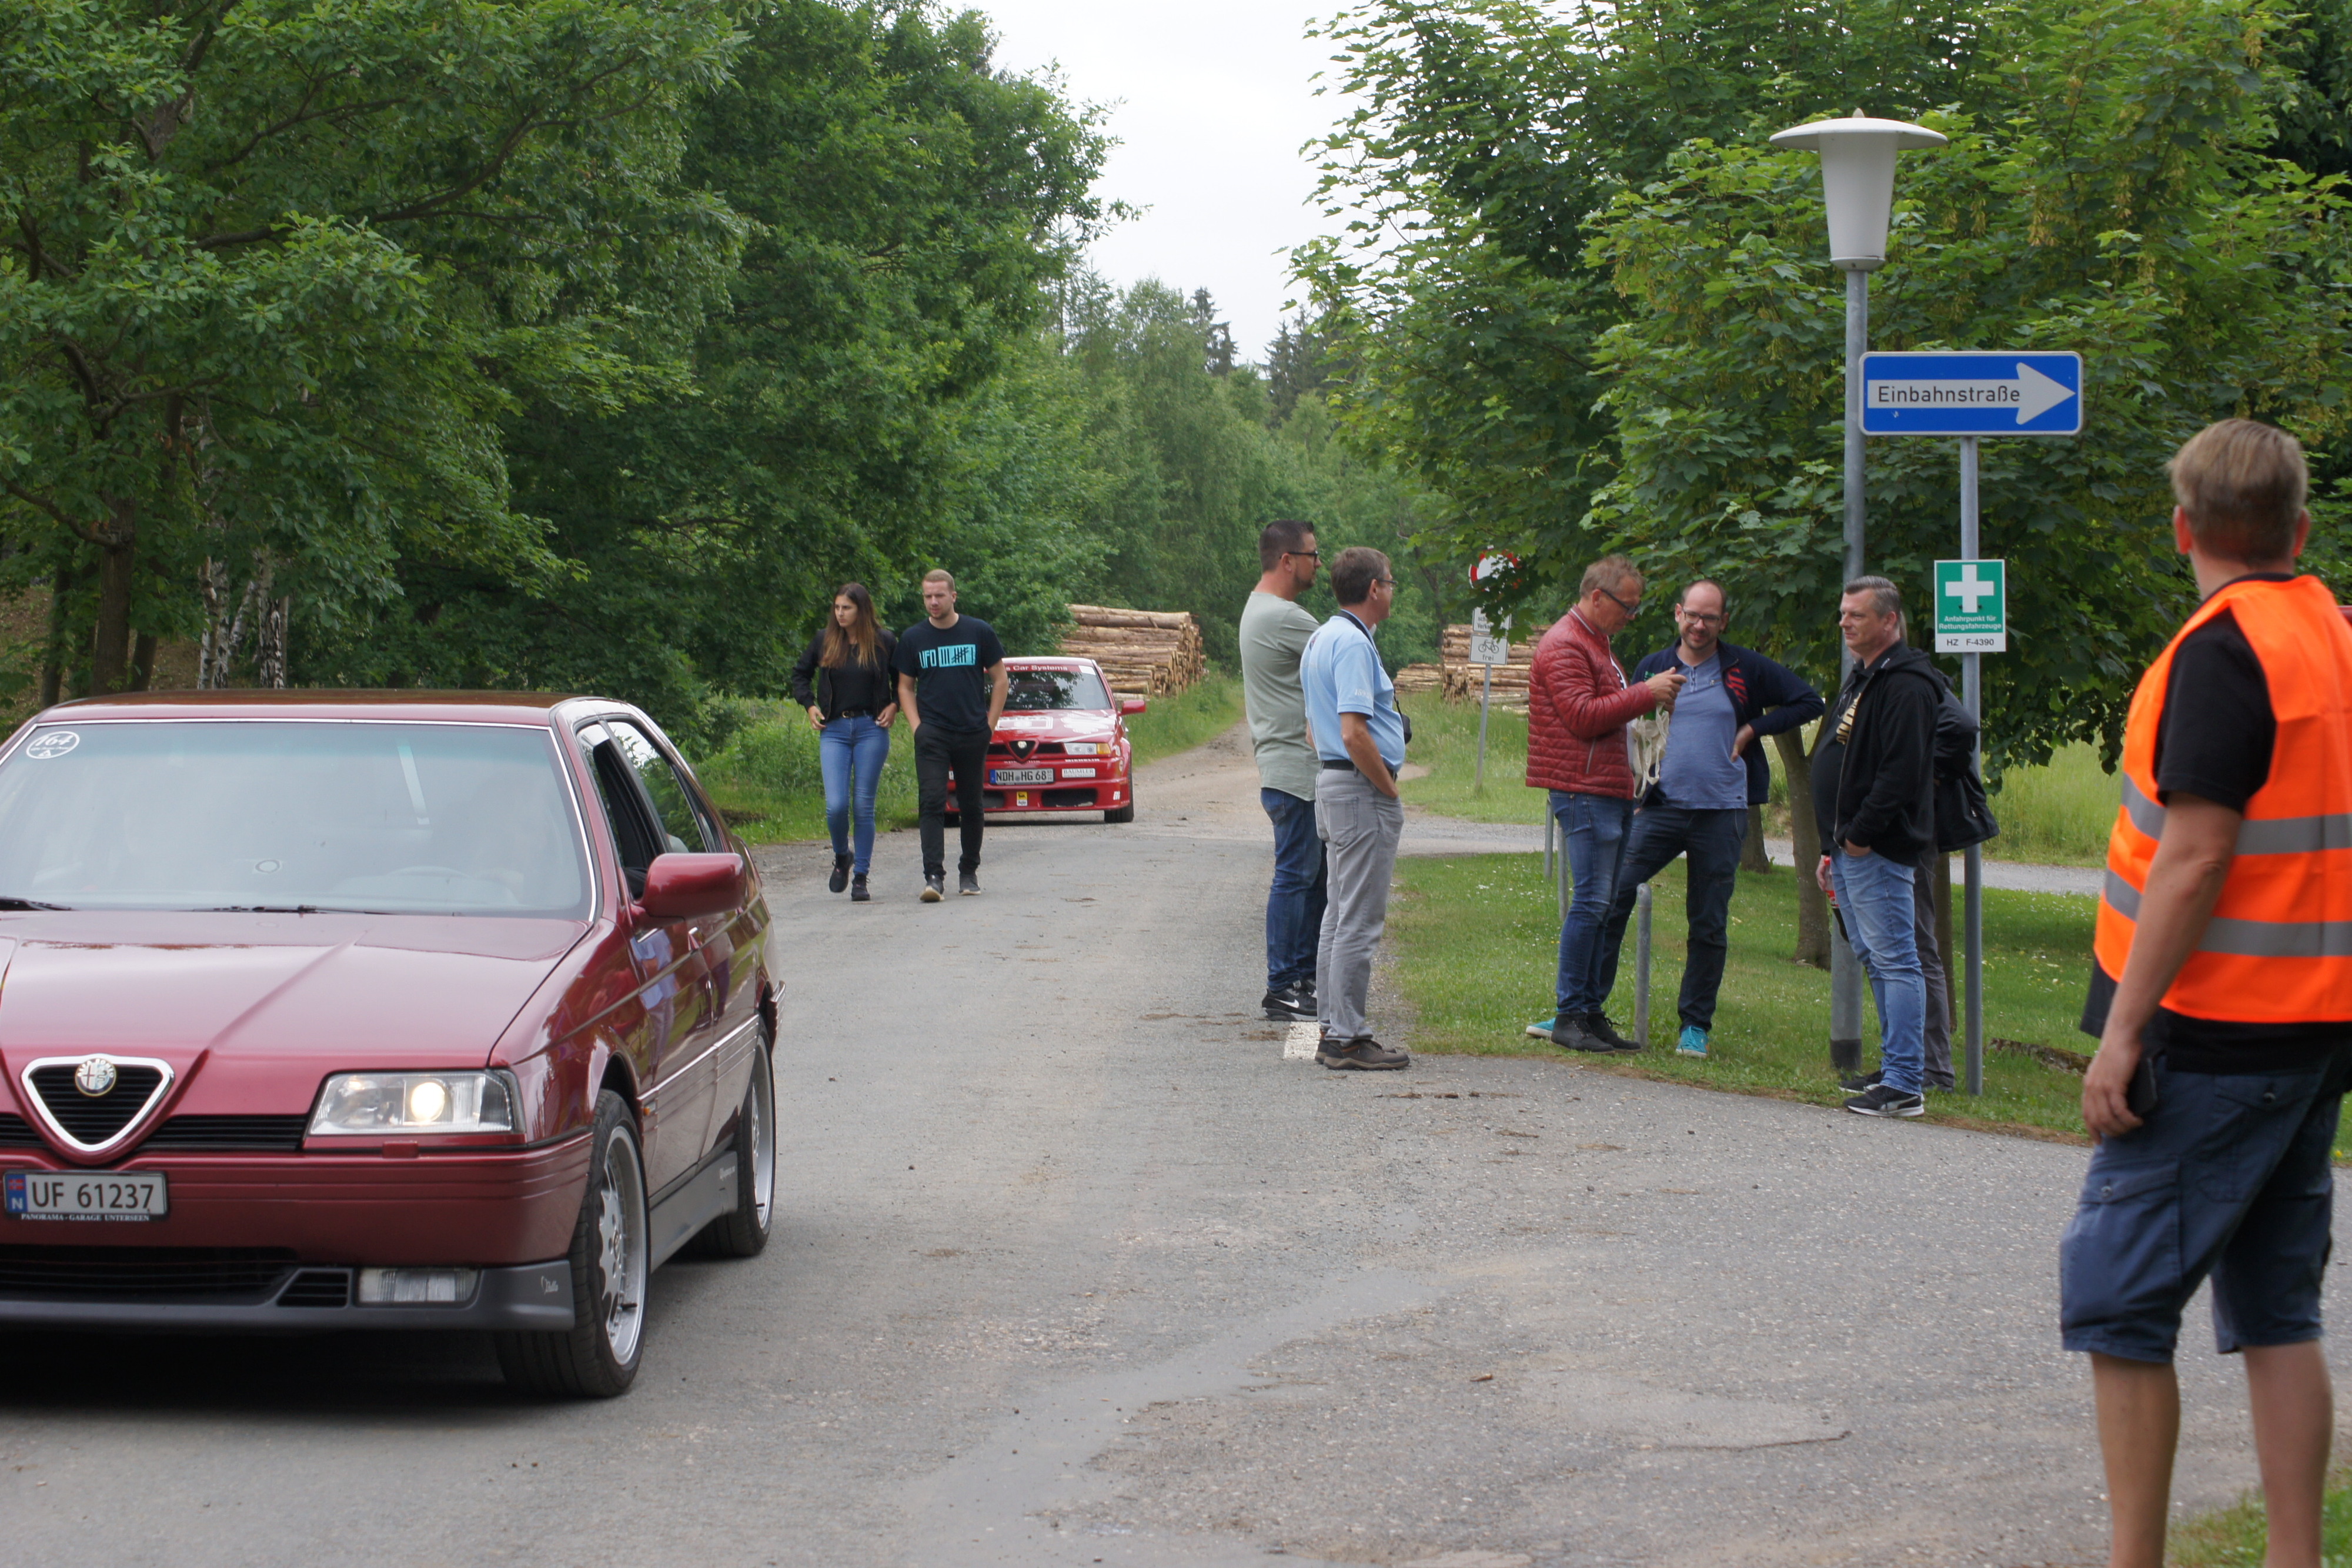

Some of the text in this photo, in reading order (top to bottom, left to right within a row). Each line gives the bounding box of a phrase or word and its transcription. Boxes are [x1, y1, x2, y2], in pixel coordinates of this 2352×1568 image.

[1879, 385, 2020, 402] Einbahnstraße
[919, 649, 937, 668] UFO
[35, 735, 74, 747] 164
[996, 771, 1014, 781] NDH
[1021, 771, 1033, 781] HG
[1035, 770, 1047, 781] 68
[32, 1182, 154, 1209] UF 61237
[11, 1198, 23, 1209] N
